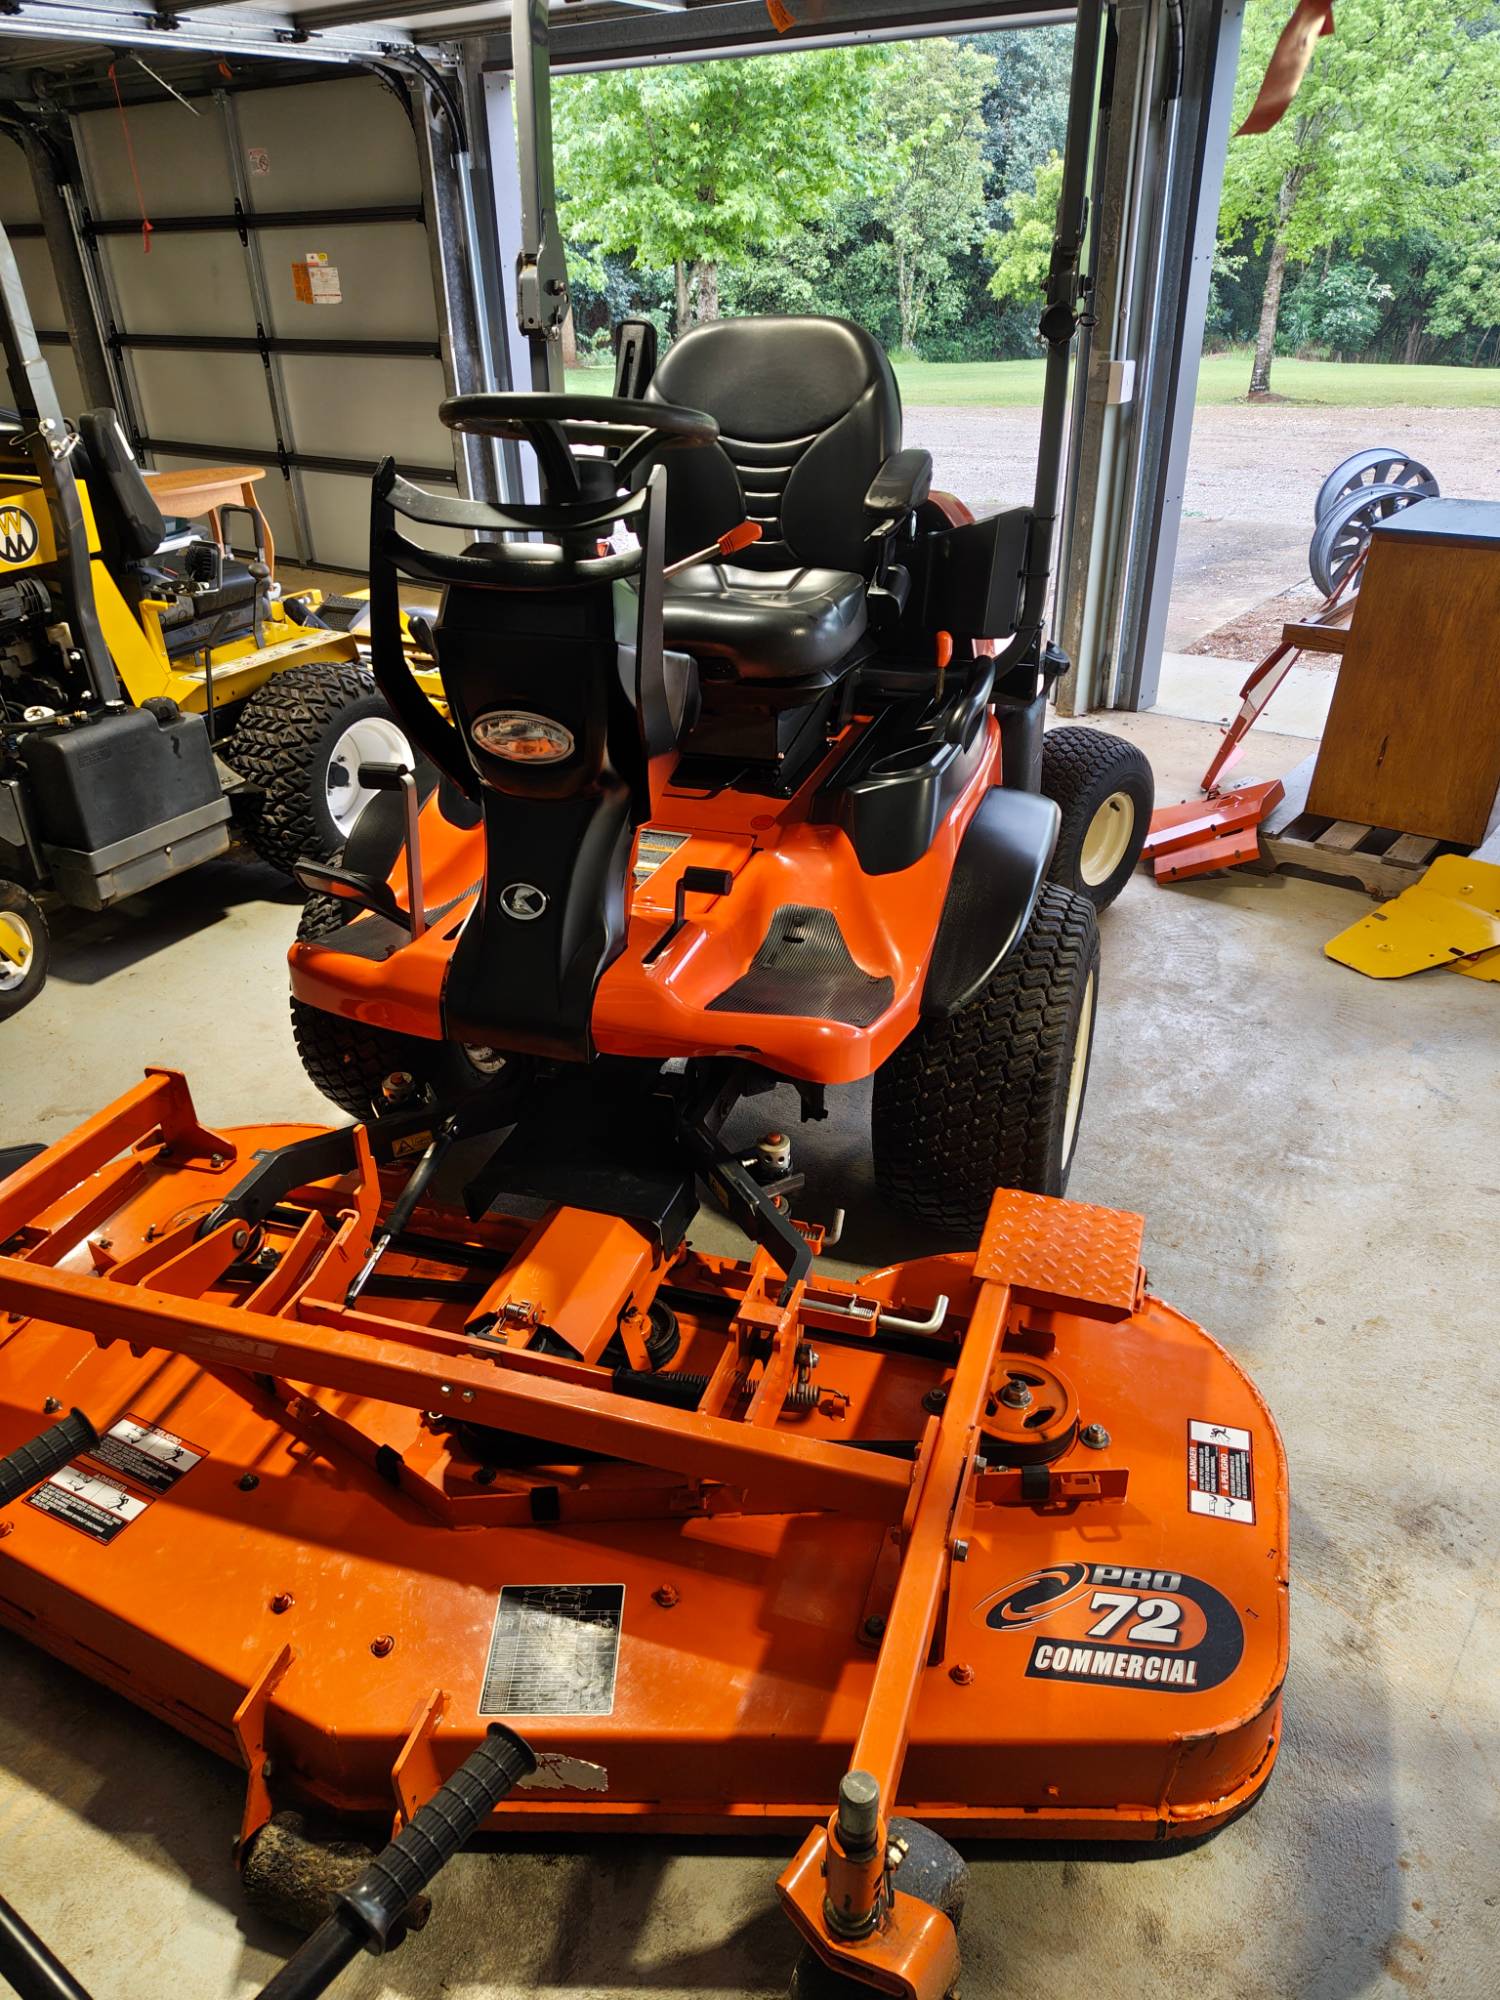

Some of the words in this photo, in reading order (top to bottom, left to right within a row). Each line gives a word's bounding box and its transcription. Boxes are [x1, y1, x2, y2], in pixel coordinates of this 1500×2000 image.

[1189, 1446, 1198, 1475] DANGER
[1220, 1453, 1229, 1483] PELIGRO
[98, 1474, 128, 1492] DANGER
[1092, 1565, 1182, 1592] PRO
[1085, 1591, 1183, 1645] 72
[1034, 1644, 1198, 1686] COMMERCIAL
